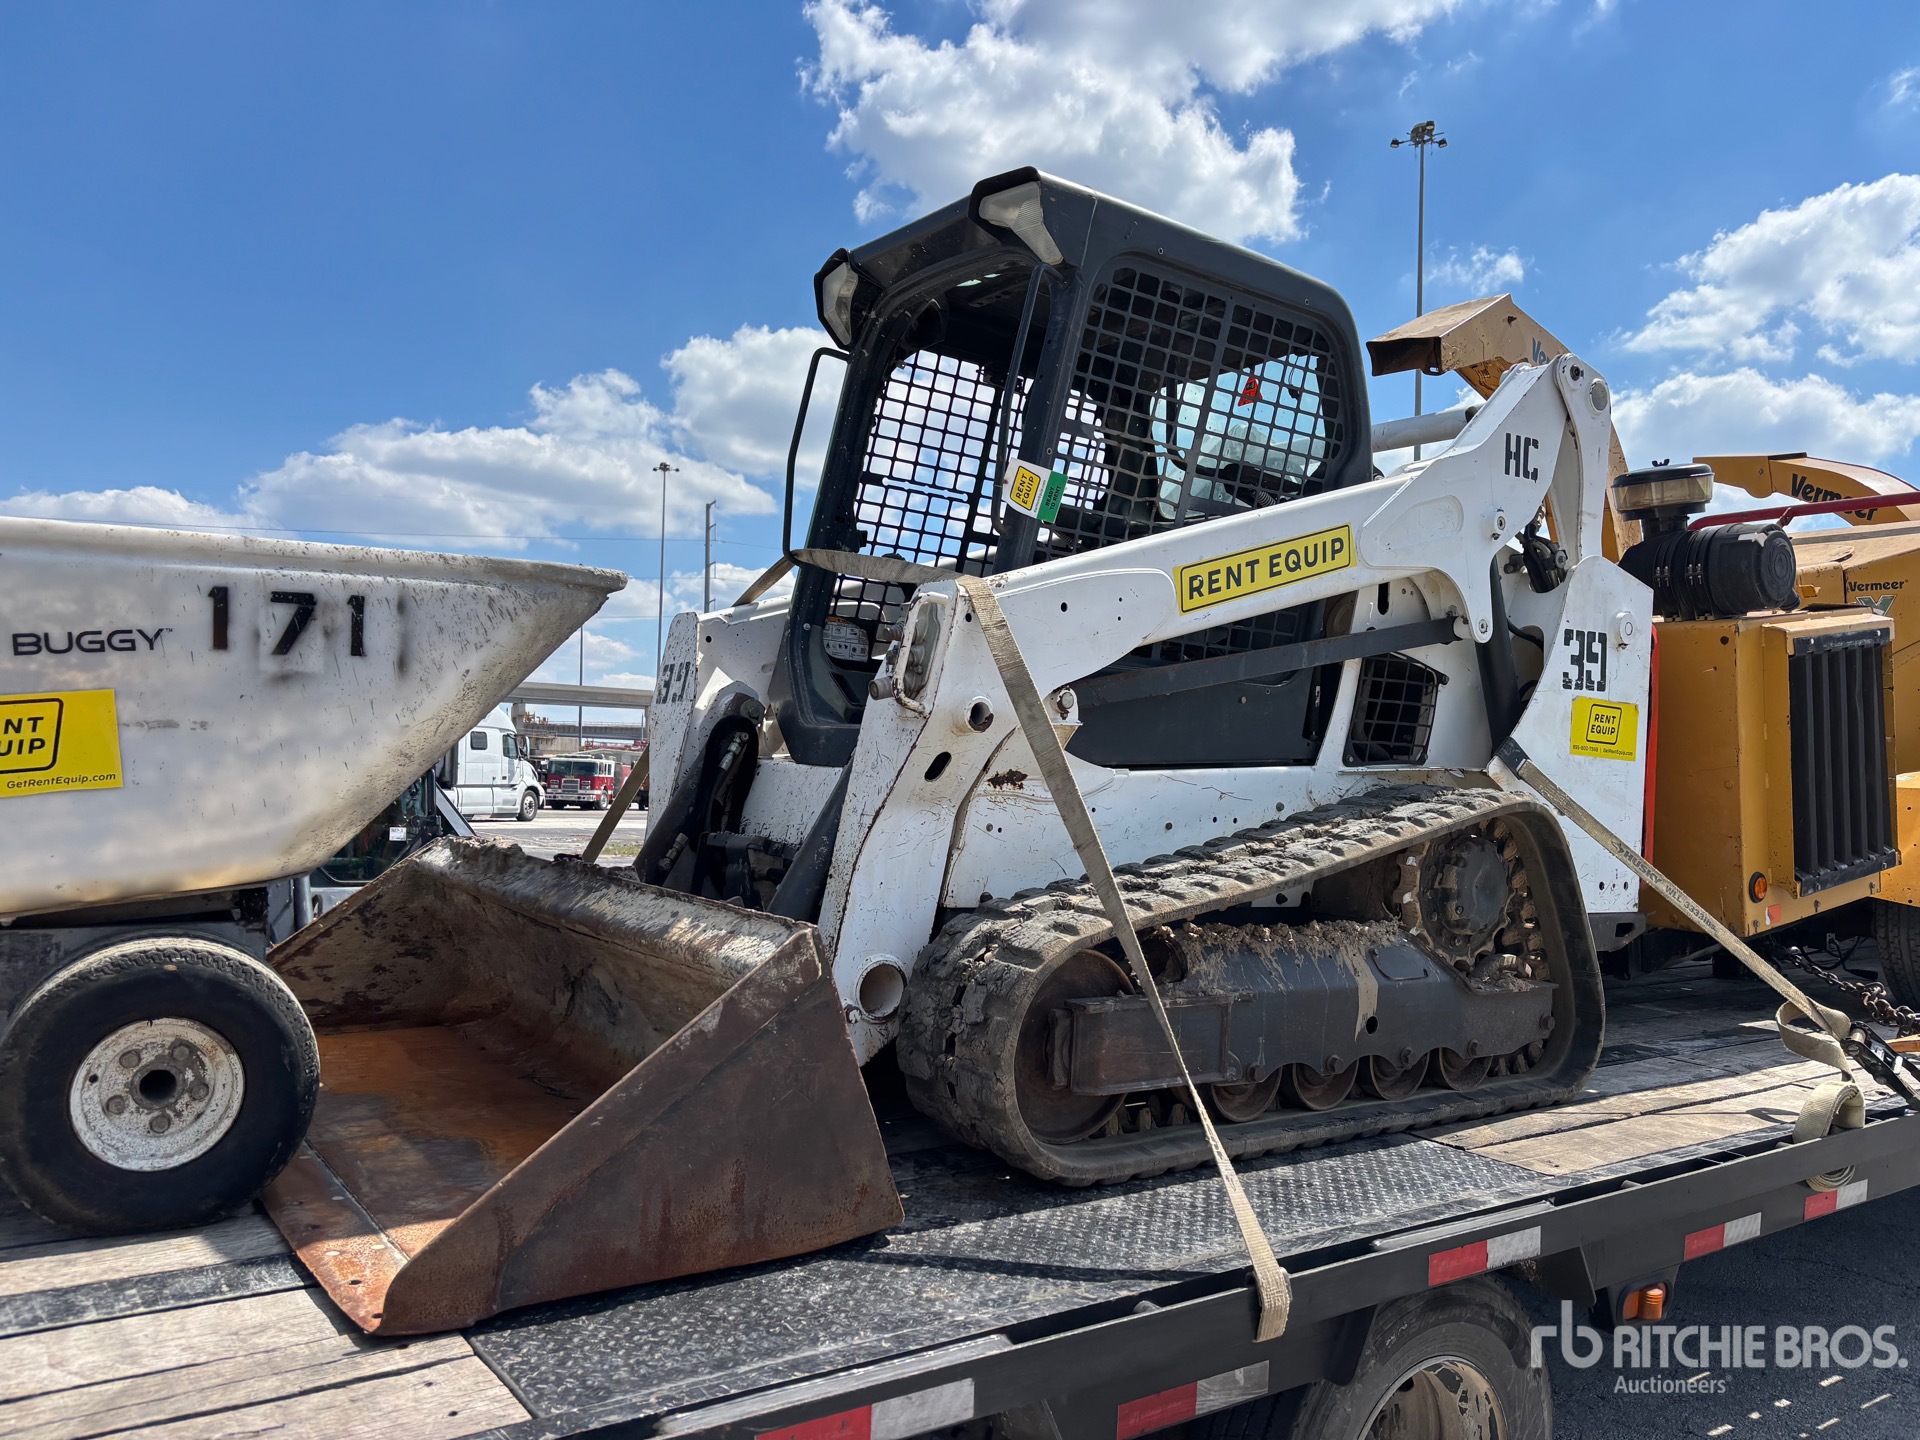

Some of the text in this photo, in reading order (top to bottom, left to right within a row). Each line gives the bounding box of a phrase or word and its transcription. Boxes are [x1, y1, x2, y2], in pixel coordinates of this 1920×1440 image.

[1505, 432, 1539, 482] HC
[1016, 474, 1027, 499] RENT
[1021, 476, 1034, 505] EQUIP
[1045, 487, 1054, 507] READY
[1050, 486, 1061, 510] TO RENT
[1188, 537, 1345, 601] RENT EQUIP
[1562, 628, 1607, 692] 39
[1591, 725, 1615, 735] EQUIP
[1594, 714, 1616, 724] RENT
[6, 773, 117, 789] GetRentEquip.com
[1623, 850, 1662, 884] HUSKY
